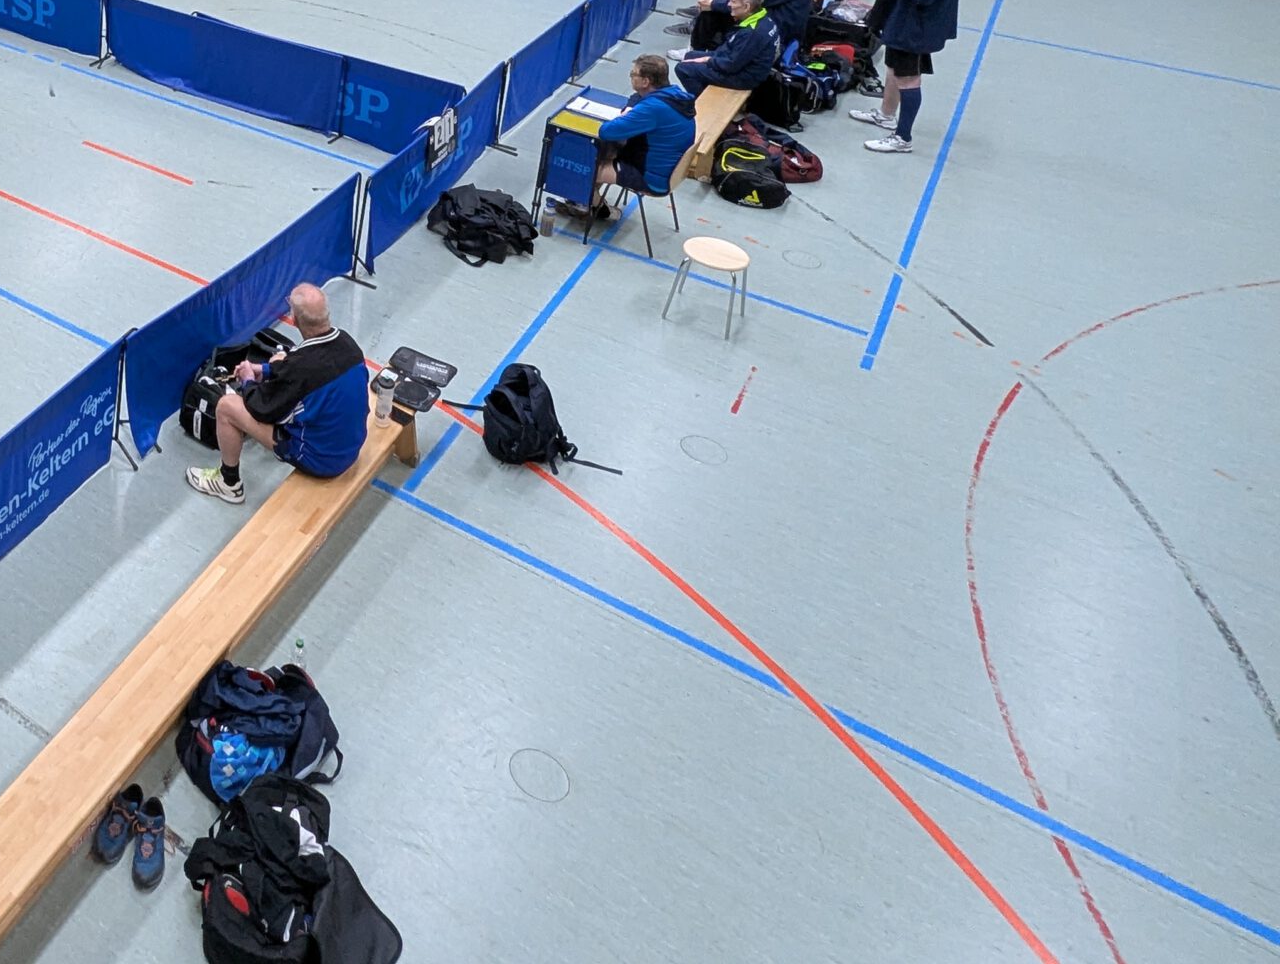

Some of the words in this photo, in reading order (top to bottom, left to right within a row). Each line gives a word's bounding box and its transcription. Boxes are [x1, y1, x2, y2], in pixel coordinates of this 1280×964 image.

[437, 126, 443, 144] 2
[565, 158, 592, 176] TSP
[28, 433, 65, 472] Partner
[65, 417, 81, 439] der
[80, 386, 112, 418] Region
[93, 404, 115, 435] eG
